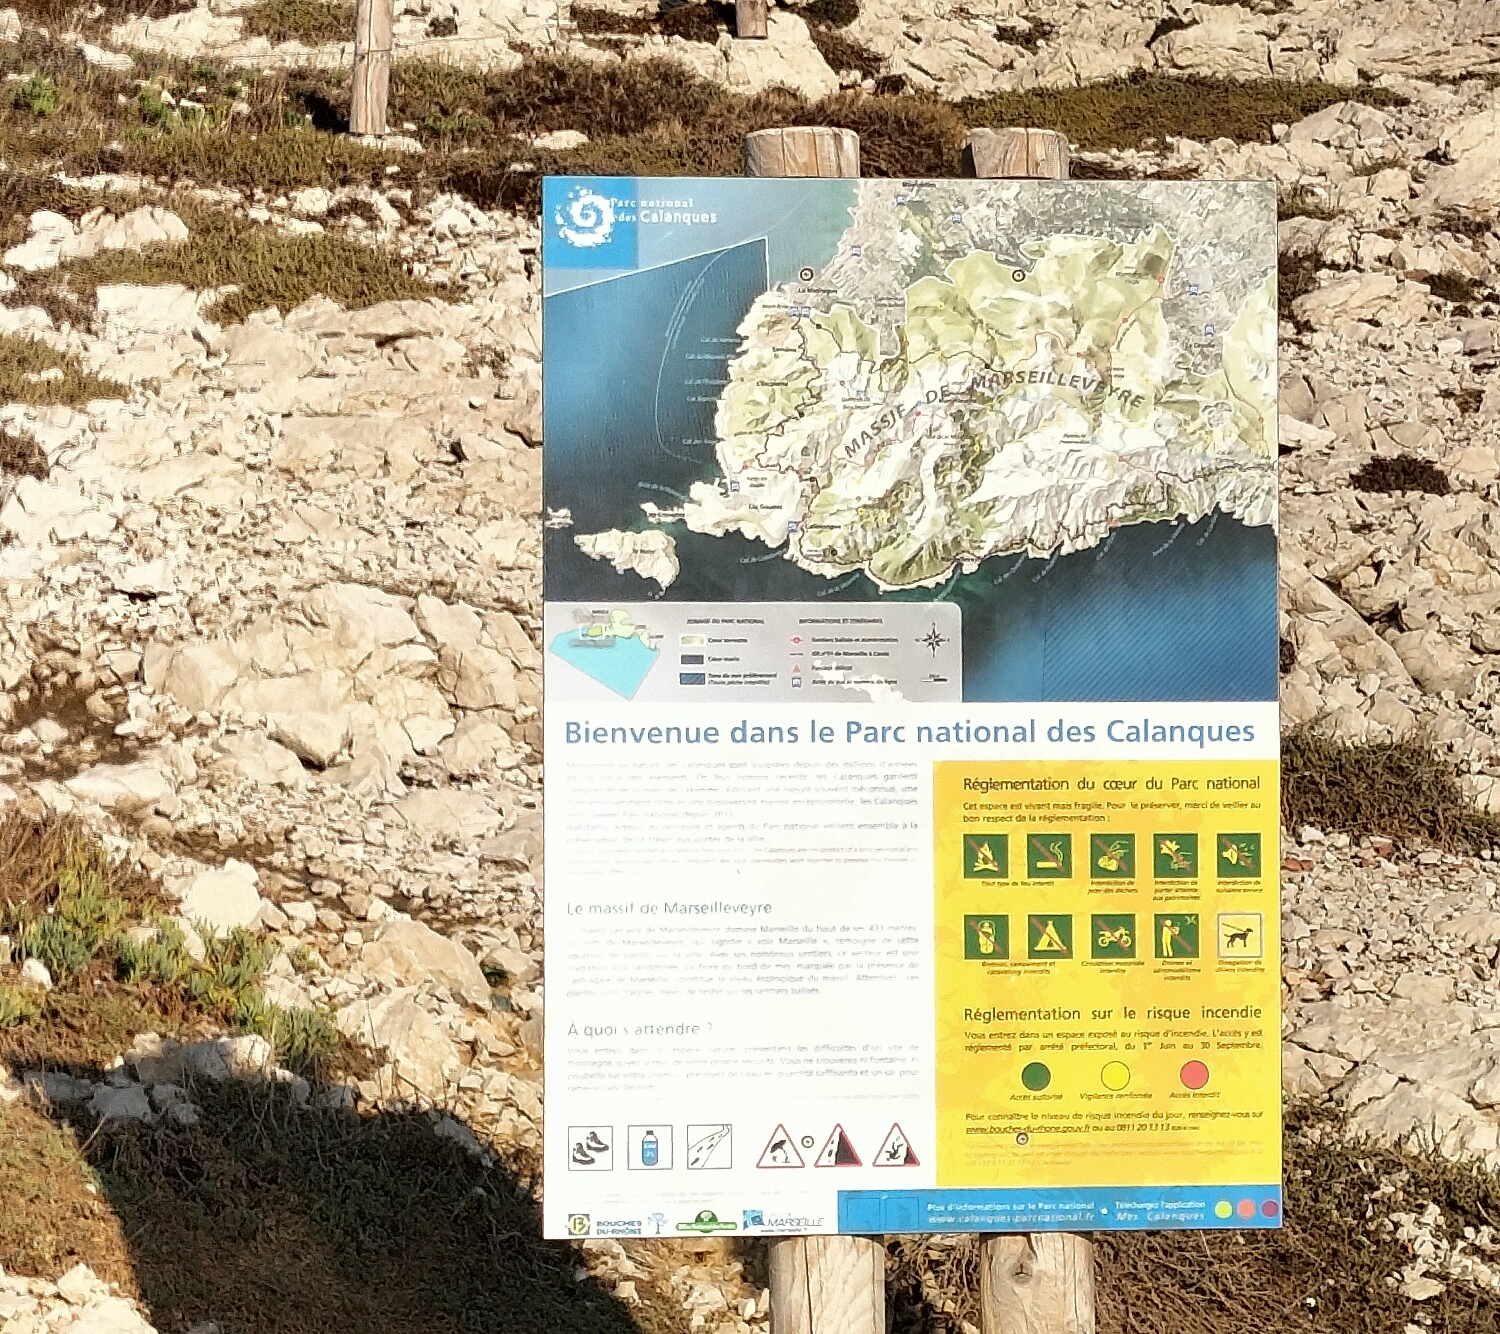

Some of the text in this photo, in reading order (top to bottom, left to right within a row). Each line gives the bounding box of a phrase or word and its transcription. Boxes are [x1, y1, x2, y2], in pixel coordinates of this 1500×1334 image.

[641, 211, 717, 225] Calanques
[845, 370, 1147, 457] MASSIF DE MARSEILLEVEYRE
[565, 718, 1256, 749] Bienvenue dans le Parc national des Calanques
[963, 777, 1069, 794] Réglementation
[1077, 777, 1096, 790] du
[1145, 777, 1163, 790] du
[1171, 777, 1199, 790] Parc
[1206, 776, 1261, 790] national
[567, 901, 772, 918] Le massif de Marseilleveyre
[964, 1005, 1262, 1024] Réglementation sur le risque incendie
[584, 1024, 617, 1039] quoi
